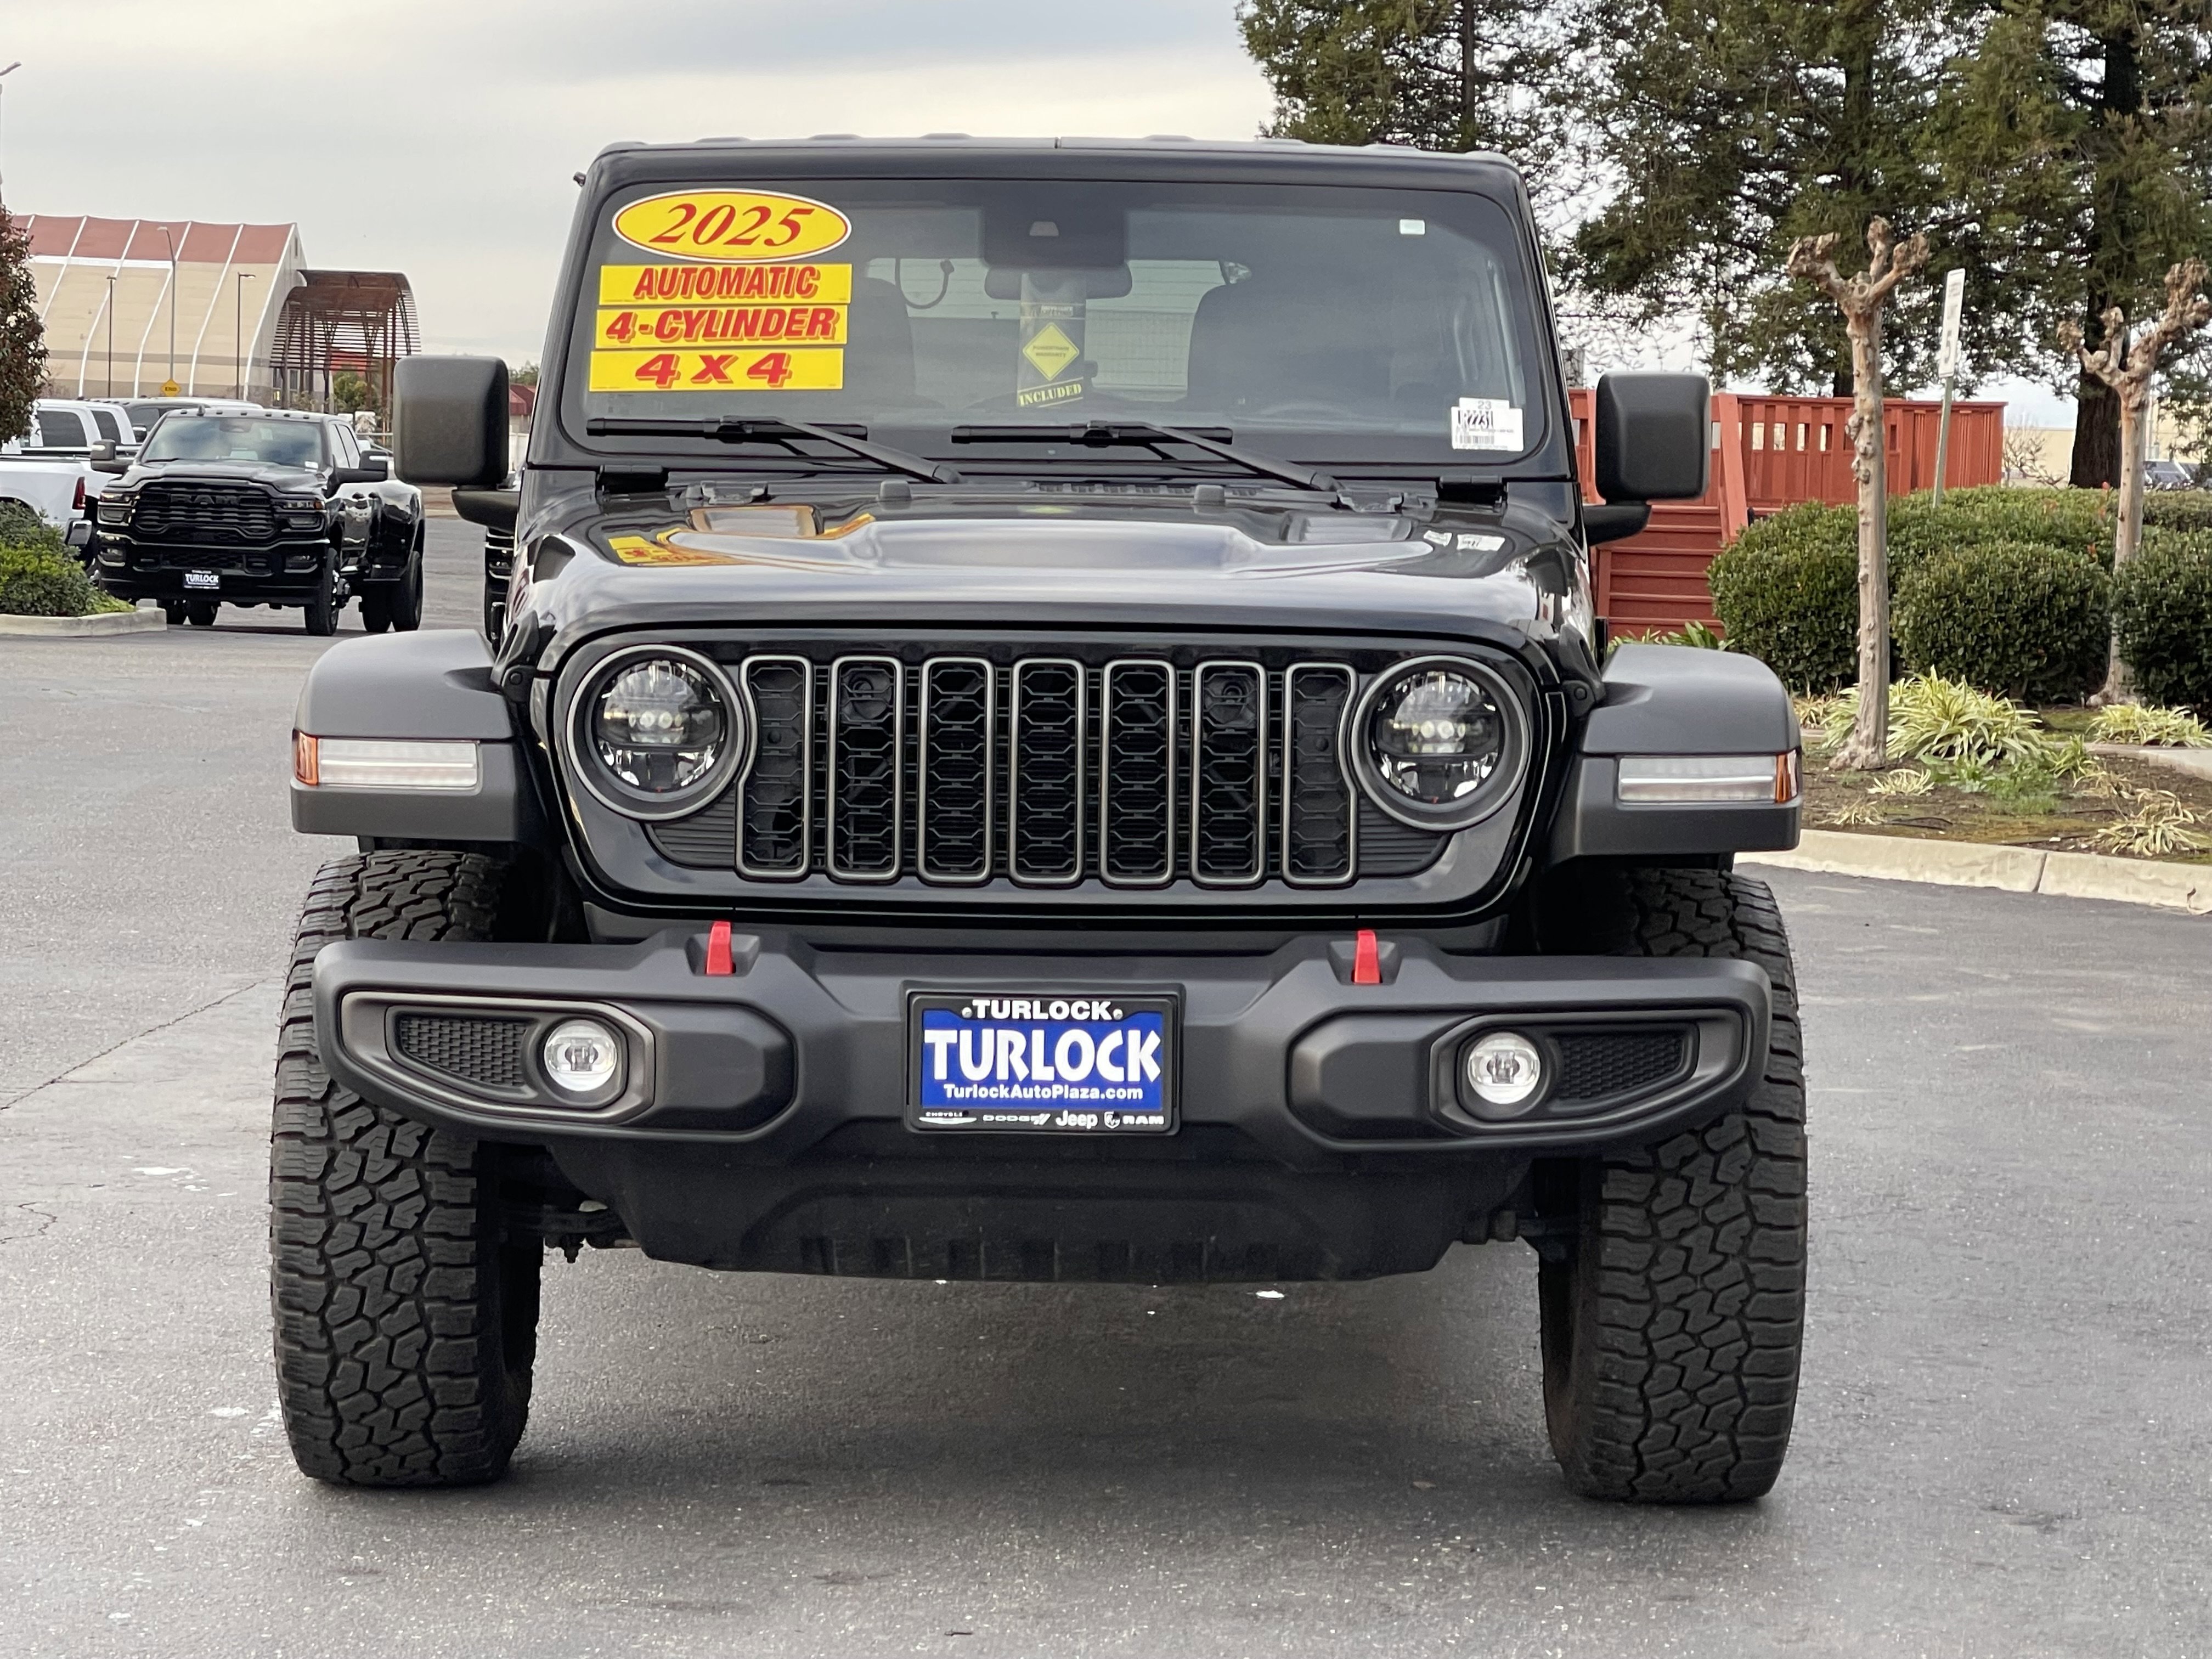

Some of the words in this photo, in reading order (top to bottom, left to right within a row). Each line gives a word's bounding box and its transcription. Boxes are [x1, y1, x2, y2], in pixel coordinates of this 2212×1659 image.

[648, 203, 815, 246] 2025
[633, 266, 820, 300] AUTOMATIC
[606, 308, 840, 343] 4-CYLINDER
[1019, 384, 1082, 407] INCLUDED
[185, 573, 219, 583] TURLOCK
[972, 1000, 1112, 1020] TURLOCK
[924, 1029, 1161, 1083] TURLOCK
[944, 1084, 1143, 1099] TurlockAutoPlaza.com
[1056, 1110, 1098, 1129] Jeep
[1123, 1115, 1164, 1125] RAM
